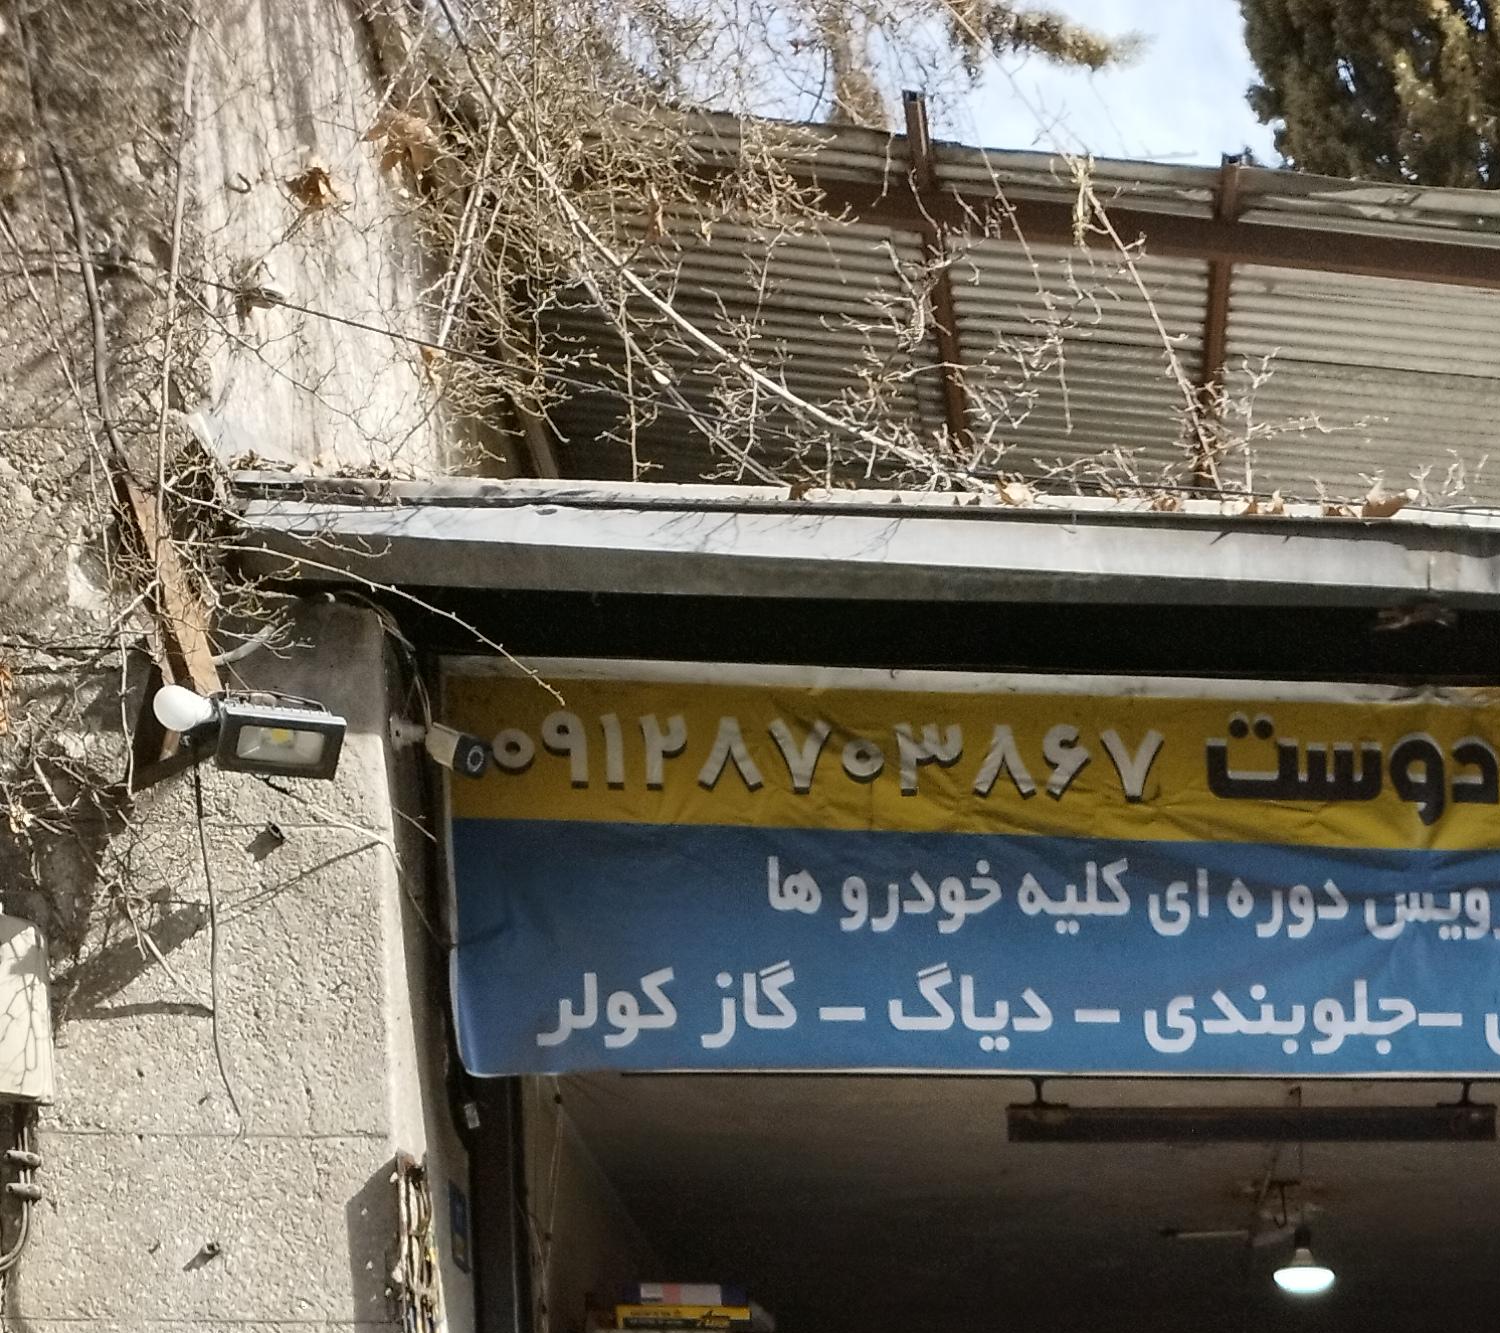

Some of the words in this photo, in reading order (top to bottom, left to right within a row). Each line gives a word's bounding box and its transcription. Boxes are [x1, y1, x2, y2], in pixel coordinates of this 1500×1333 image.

[492, 709, 1164, 801] ۰۹۱۲۸۷۰۳۸۶۷
[1206, 712, 1499, 826] دوست
[767, 856, 823, 915] ها
[839, 858, 1003, 935] خودرو
[1017, 859, 1131, 936] کلیه
[1147, 868, 1209, 937] ای
[1226, 878, 1350, 940] دوره
[536, 967, 678, 1048] کولر
[699, 960, 799, 1050] گاز
[887, 961, 1055, 1053] دیاگ
